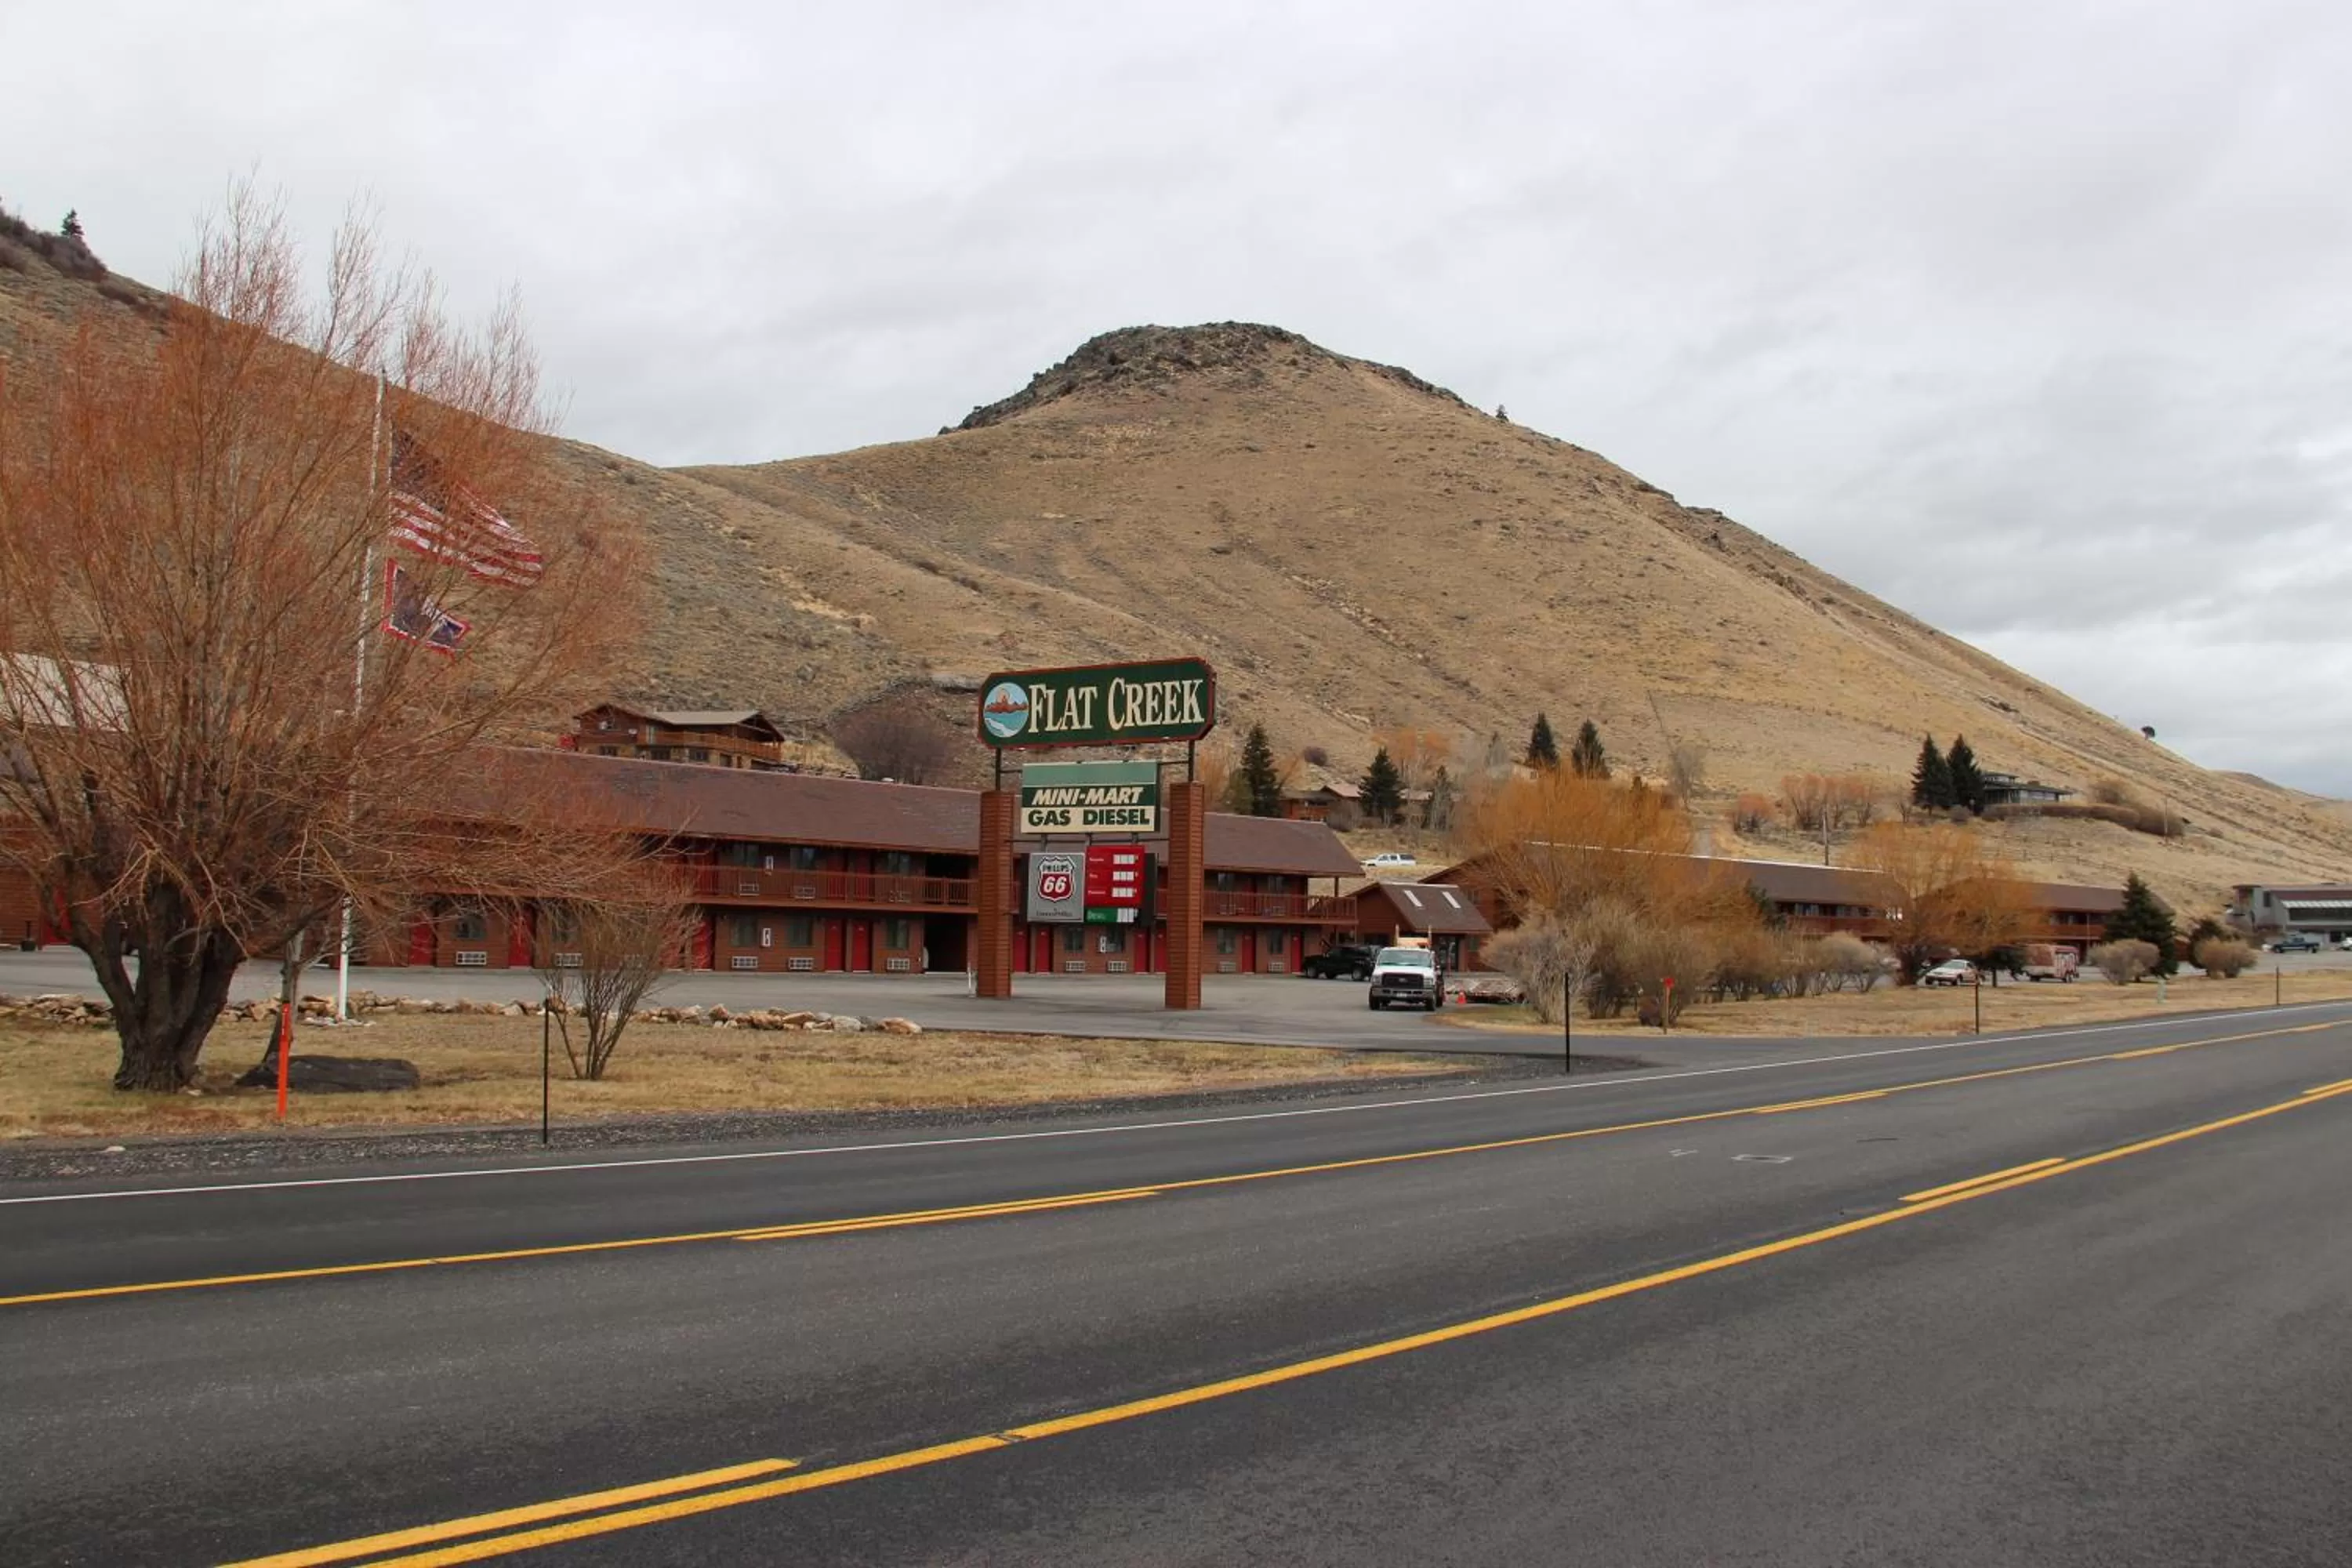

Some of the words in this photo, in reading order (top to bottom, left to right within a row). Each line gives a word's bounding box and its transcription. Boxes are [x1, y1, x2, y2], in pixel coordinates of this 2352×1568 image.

[1028, 683, 1098, 733] FLAT
[1108, 677, 1205, 731] CREEK
[1031, 786, 1144, 806] MINI-MART
[1028, 808, 1071, 826] GAS
[1082, 808, 1150, 826] DIESEL
[1043, 876, 1067, 893] 66
